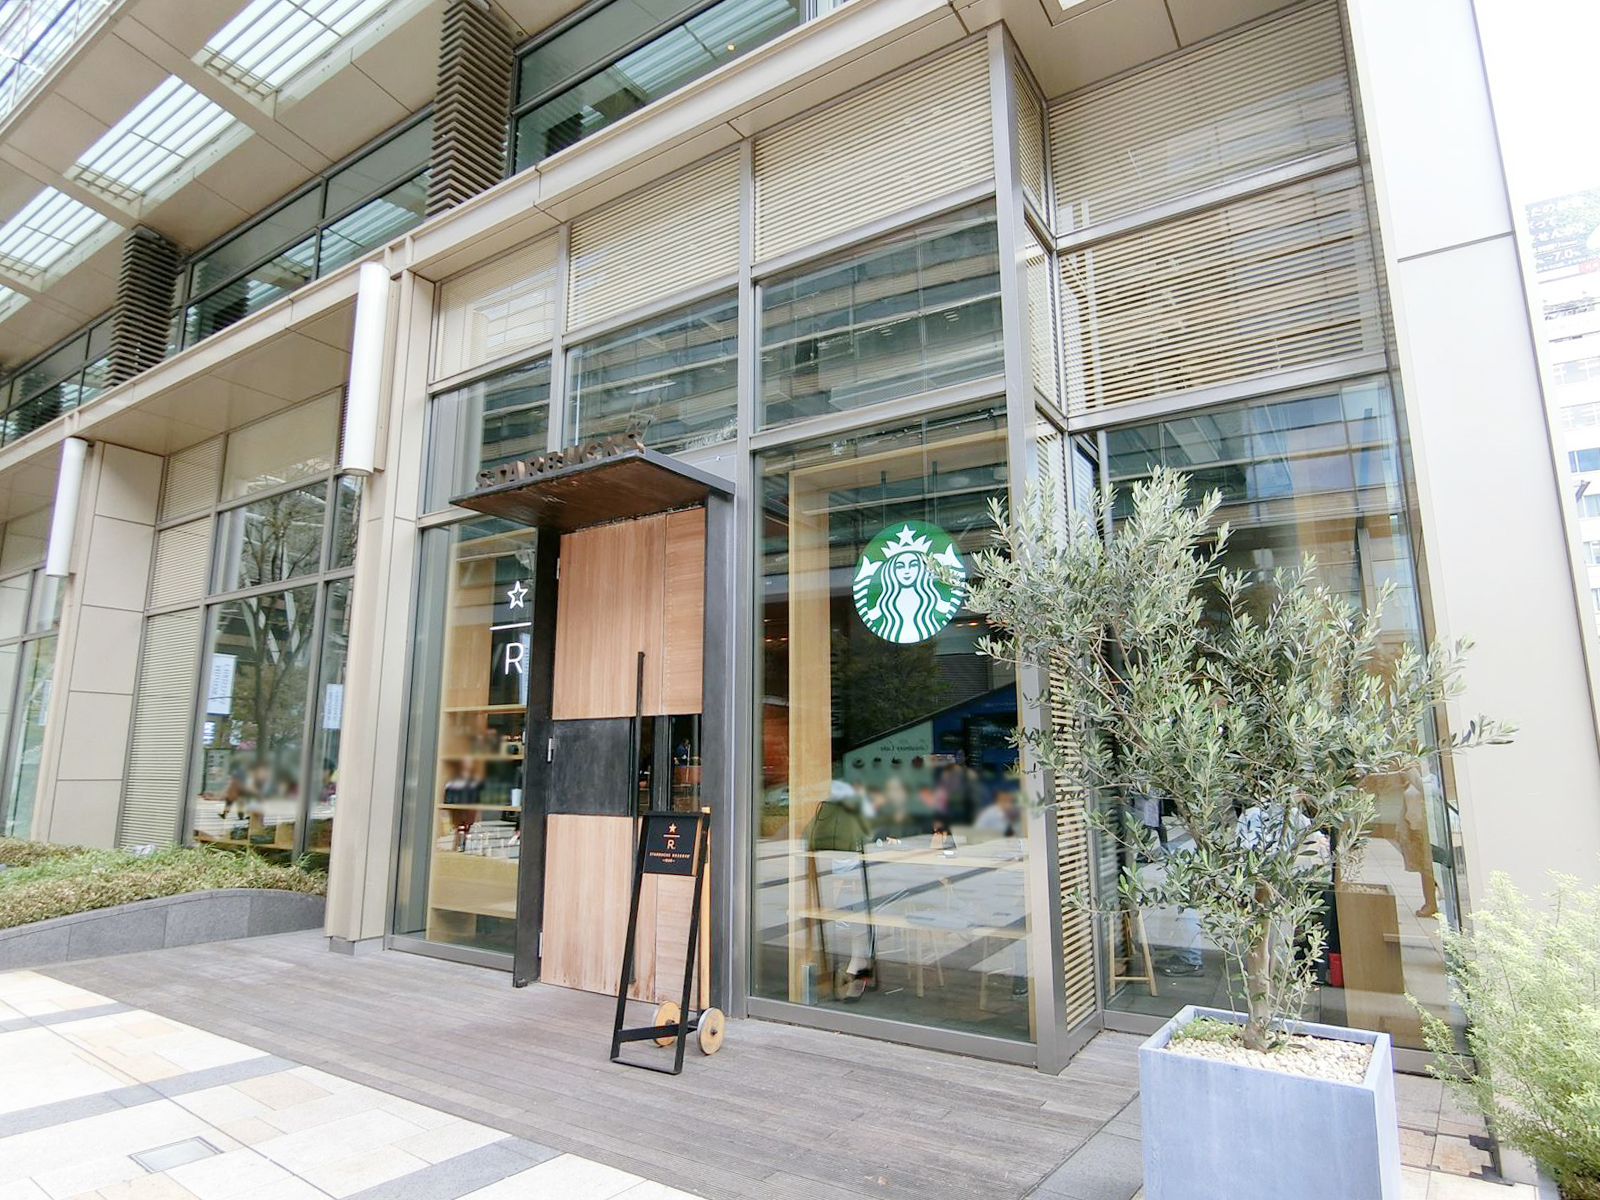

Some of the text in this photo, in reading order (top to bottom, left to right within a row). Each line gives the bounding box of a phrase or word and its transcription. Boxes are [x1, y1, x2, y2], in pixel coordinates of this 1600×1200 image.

[476, 430, 646, 488] STARBUCKS
[505, 642, 524, 675] R
[667, 839, 676, 850] R
